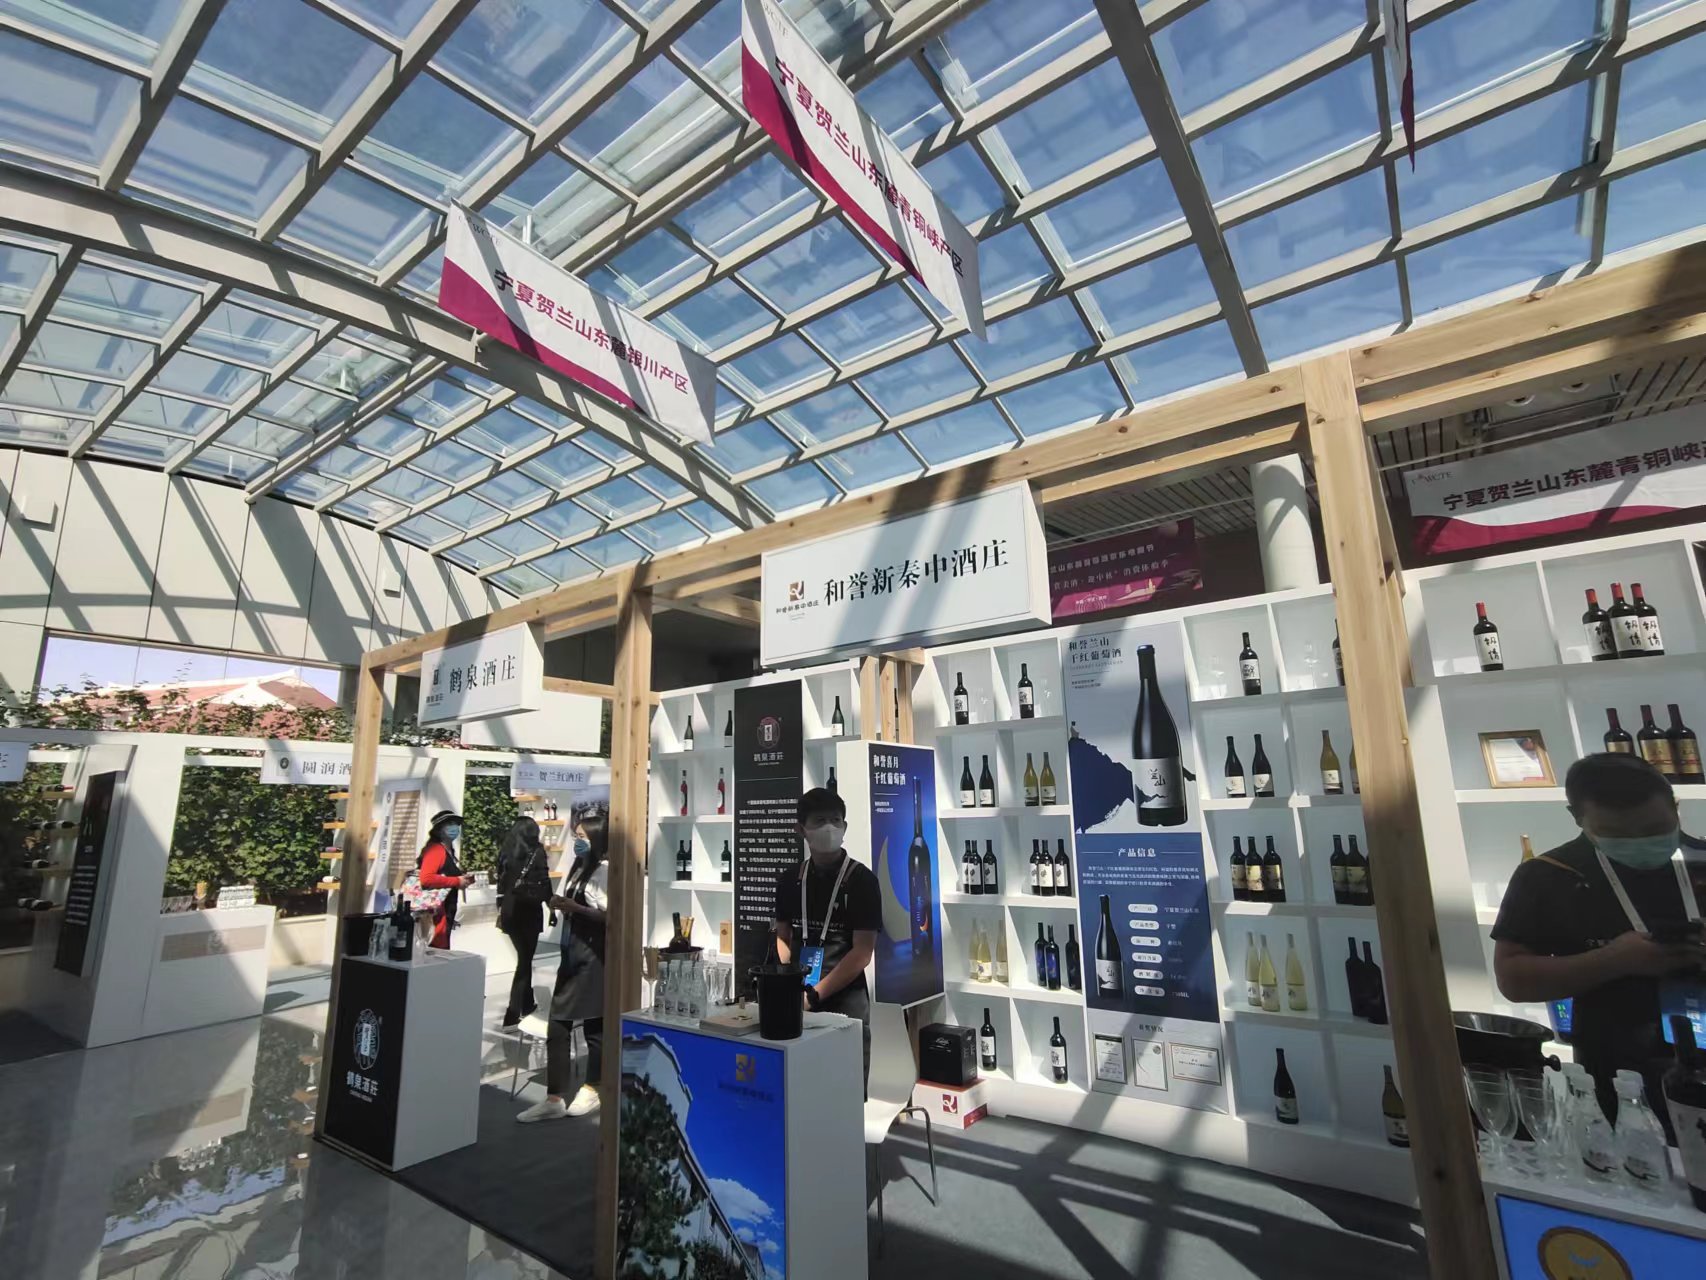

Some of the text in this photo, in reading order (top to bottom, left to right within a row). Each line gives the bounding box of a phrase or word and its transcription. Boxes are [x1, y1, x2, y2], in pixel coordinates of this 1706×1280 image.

[775, 55, 964, 278] 宁夏贺兰山东麓青铜峡产区
[494, 268, 688, 395] 宁夏贺兰山东麓银川产区
[824, 539, 1008, 606] 和誉新秦中酒庄
[449, 654, 516, 694] 鹤泉酒庄
[1117, 847, 1157, 858] 产品信息
